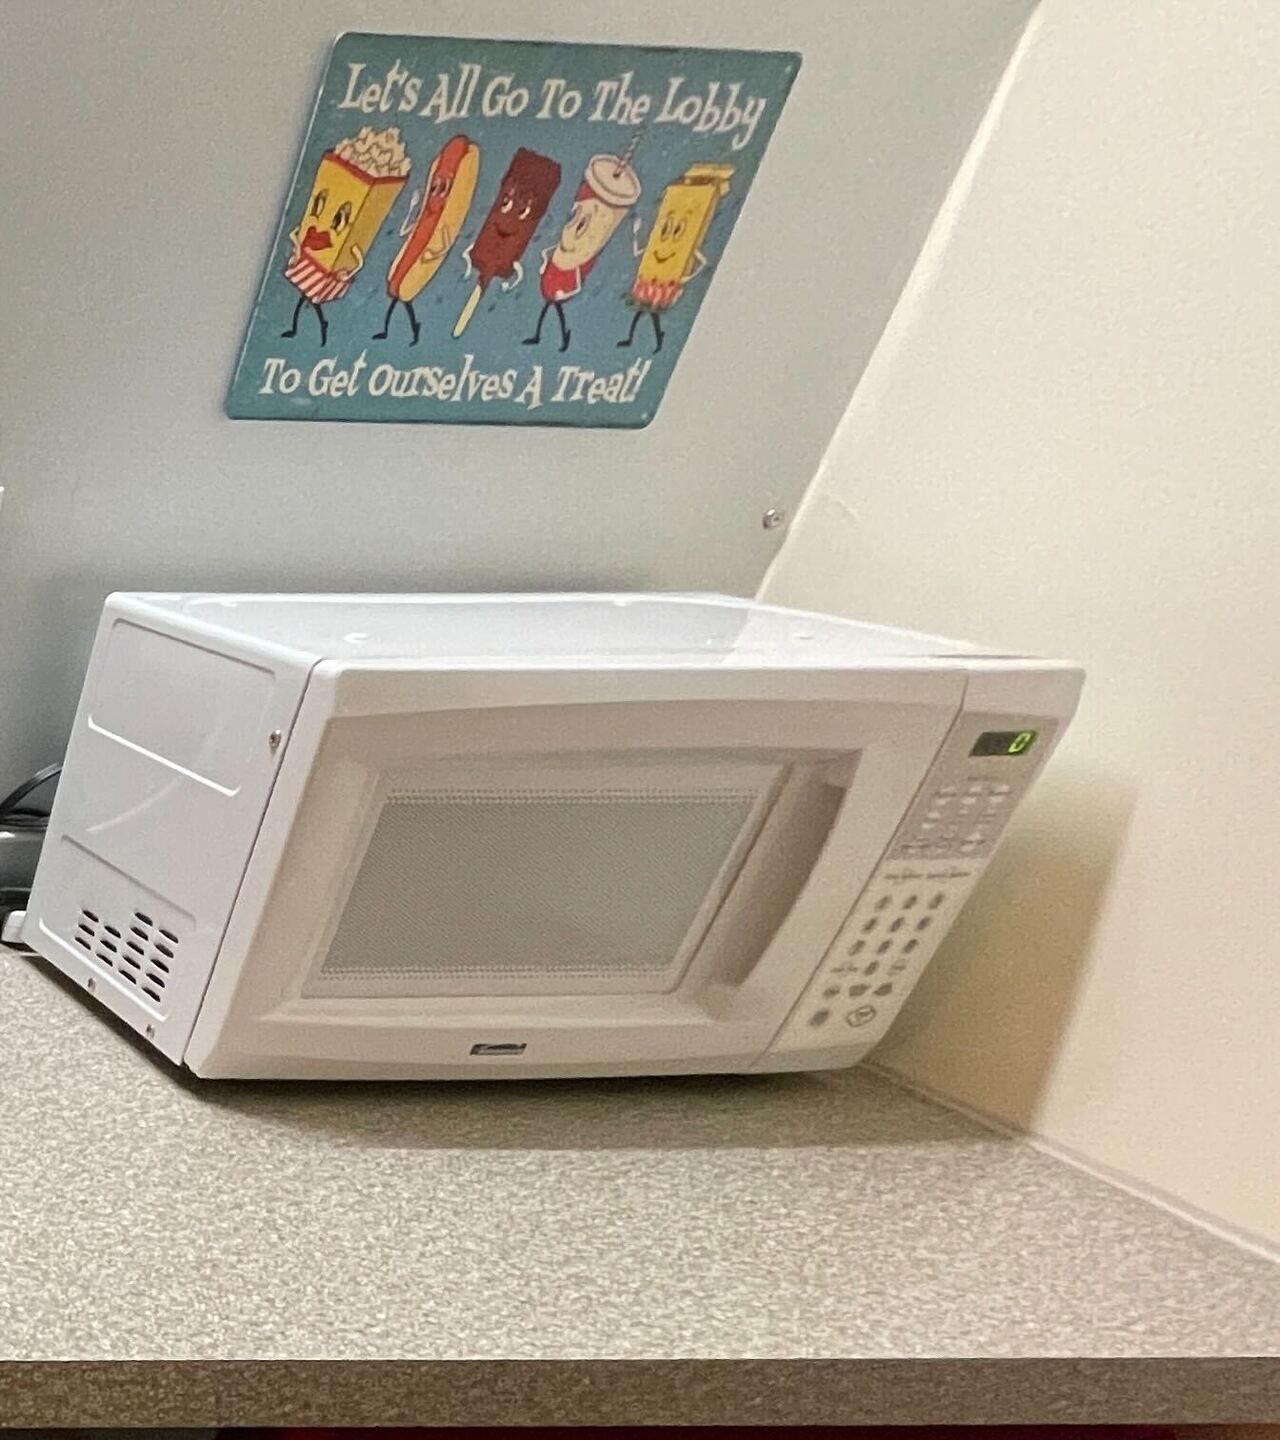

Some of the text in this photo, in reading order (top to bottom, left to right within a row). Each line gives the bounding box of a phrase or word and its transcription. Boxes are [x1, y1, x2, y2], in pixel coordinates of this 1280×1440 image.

[337, 58, 768, 151] Let's All Go To The Lobby
[258, 357, 302, 395] To
[308, 348, 368, 398] Get
[514, 365, 544, 410] A
[550, 356, 653, 405] Treat!
